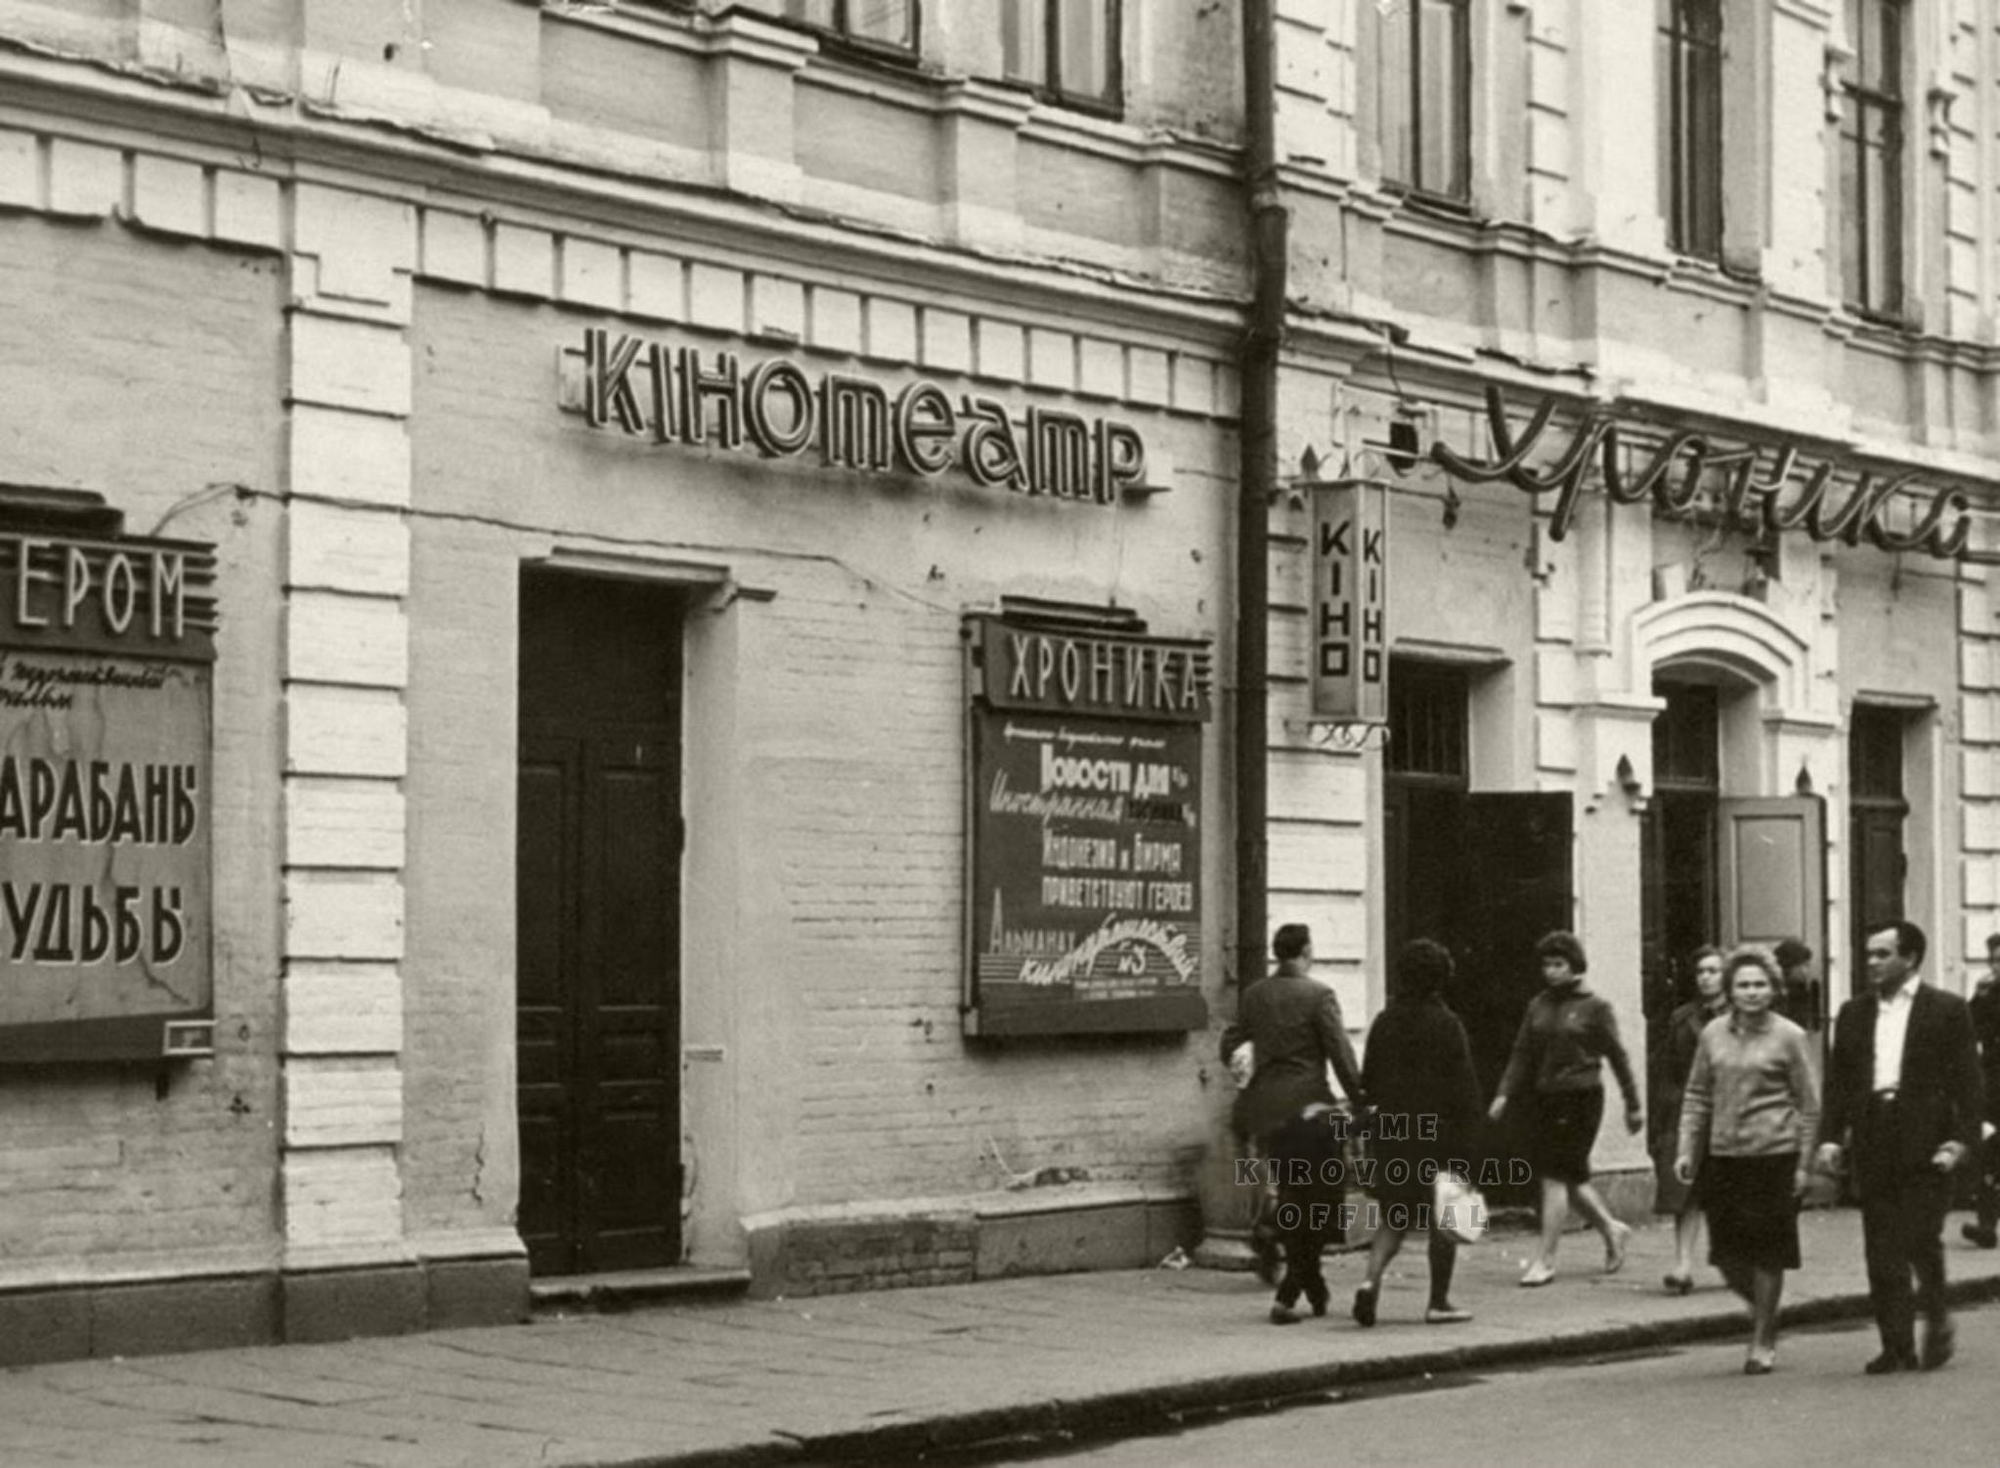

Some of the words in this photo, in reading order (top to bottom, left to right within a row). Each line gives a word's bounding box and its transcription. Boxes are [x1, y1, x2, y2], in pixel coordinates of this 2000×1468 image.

[1010, 633, 1199, 709] ХРОНИКА
[1320, 519, 1351, 678] КІНО
[1362, 526, 1382, 684] КІНО
